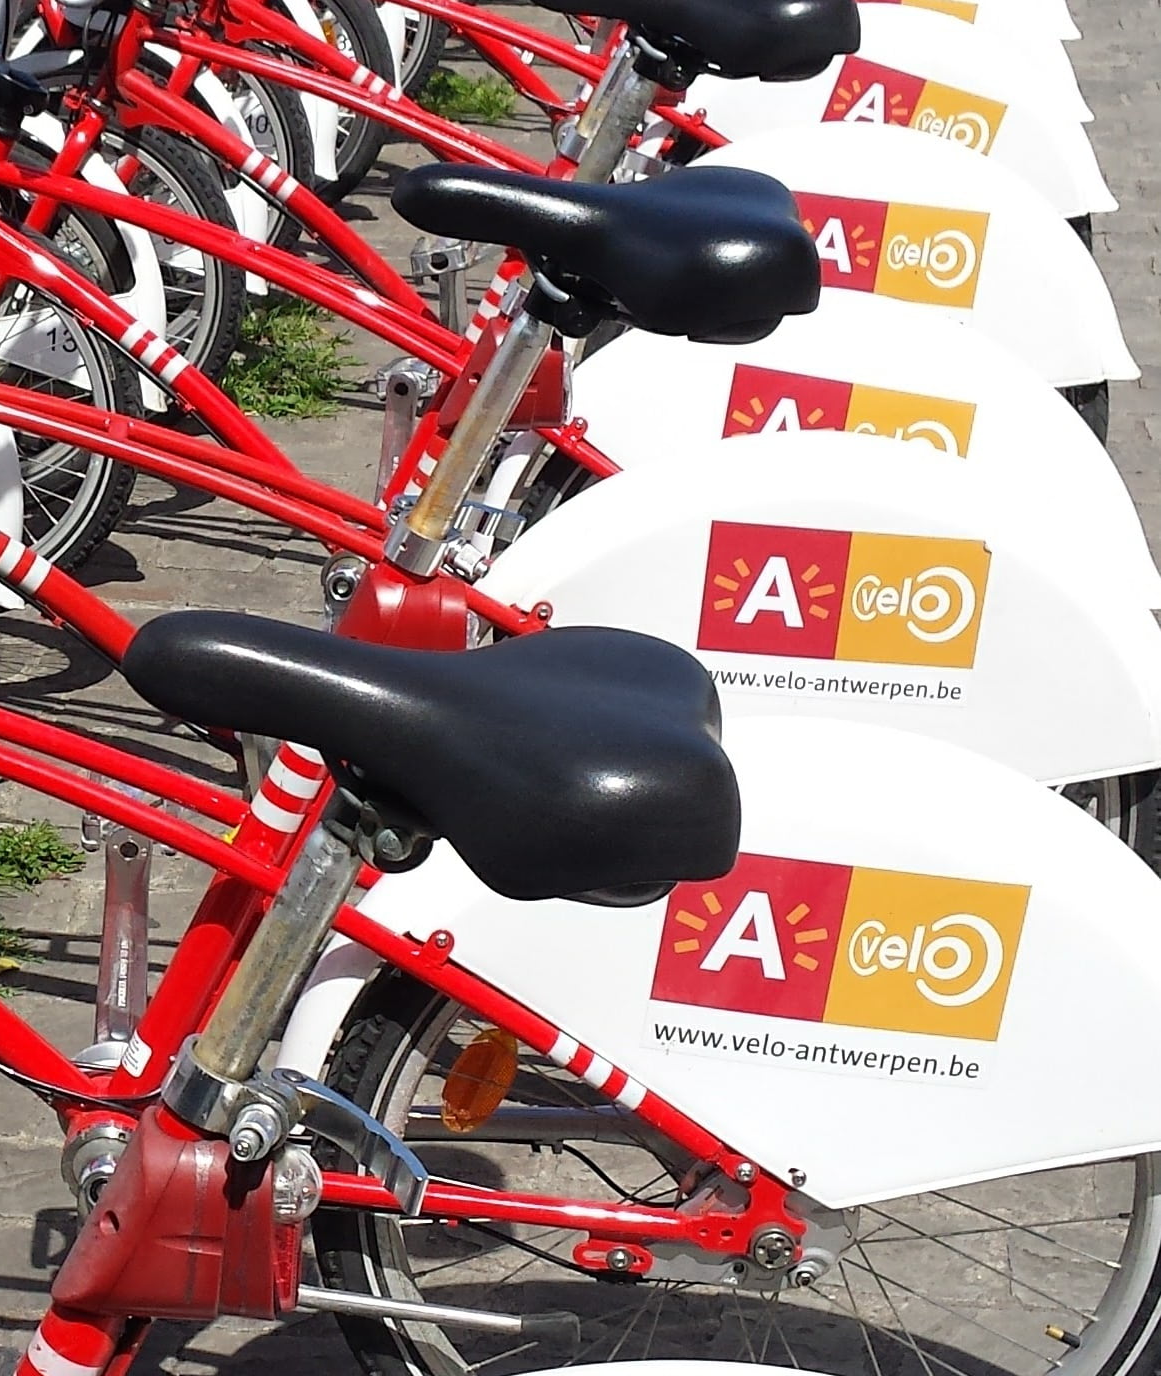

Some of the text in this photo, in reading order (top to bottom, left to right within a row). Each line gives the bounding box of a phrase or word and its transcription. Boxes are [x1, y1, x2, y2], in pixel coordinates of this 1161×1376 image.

[813, 216, 852, 274] A
[734, 555, 805, 629] A
[700, 891, 786, 980] A
[655, 1022, 980, 1080] www.velo-antwerpen.be
